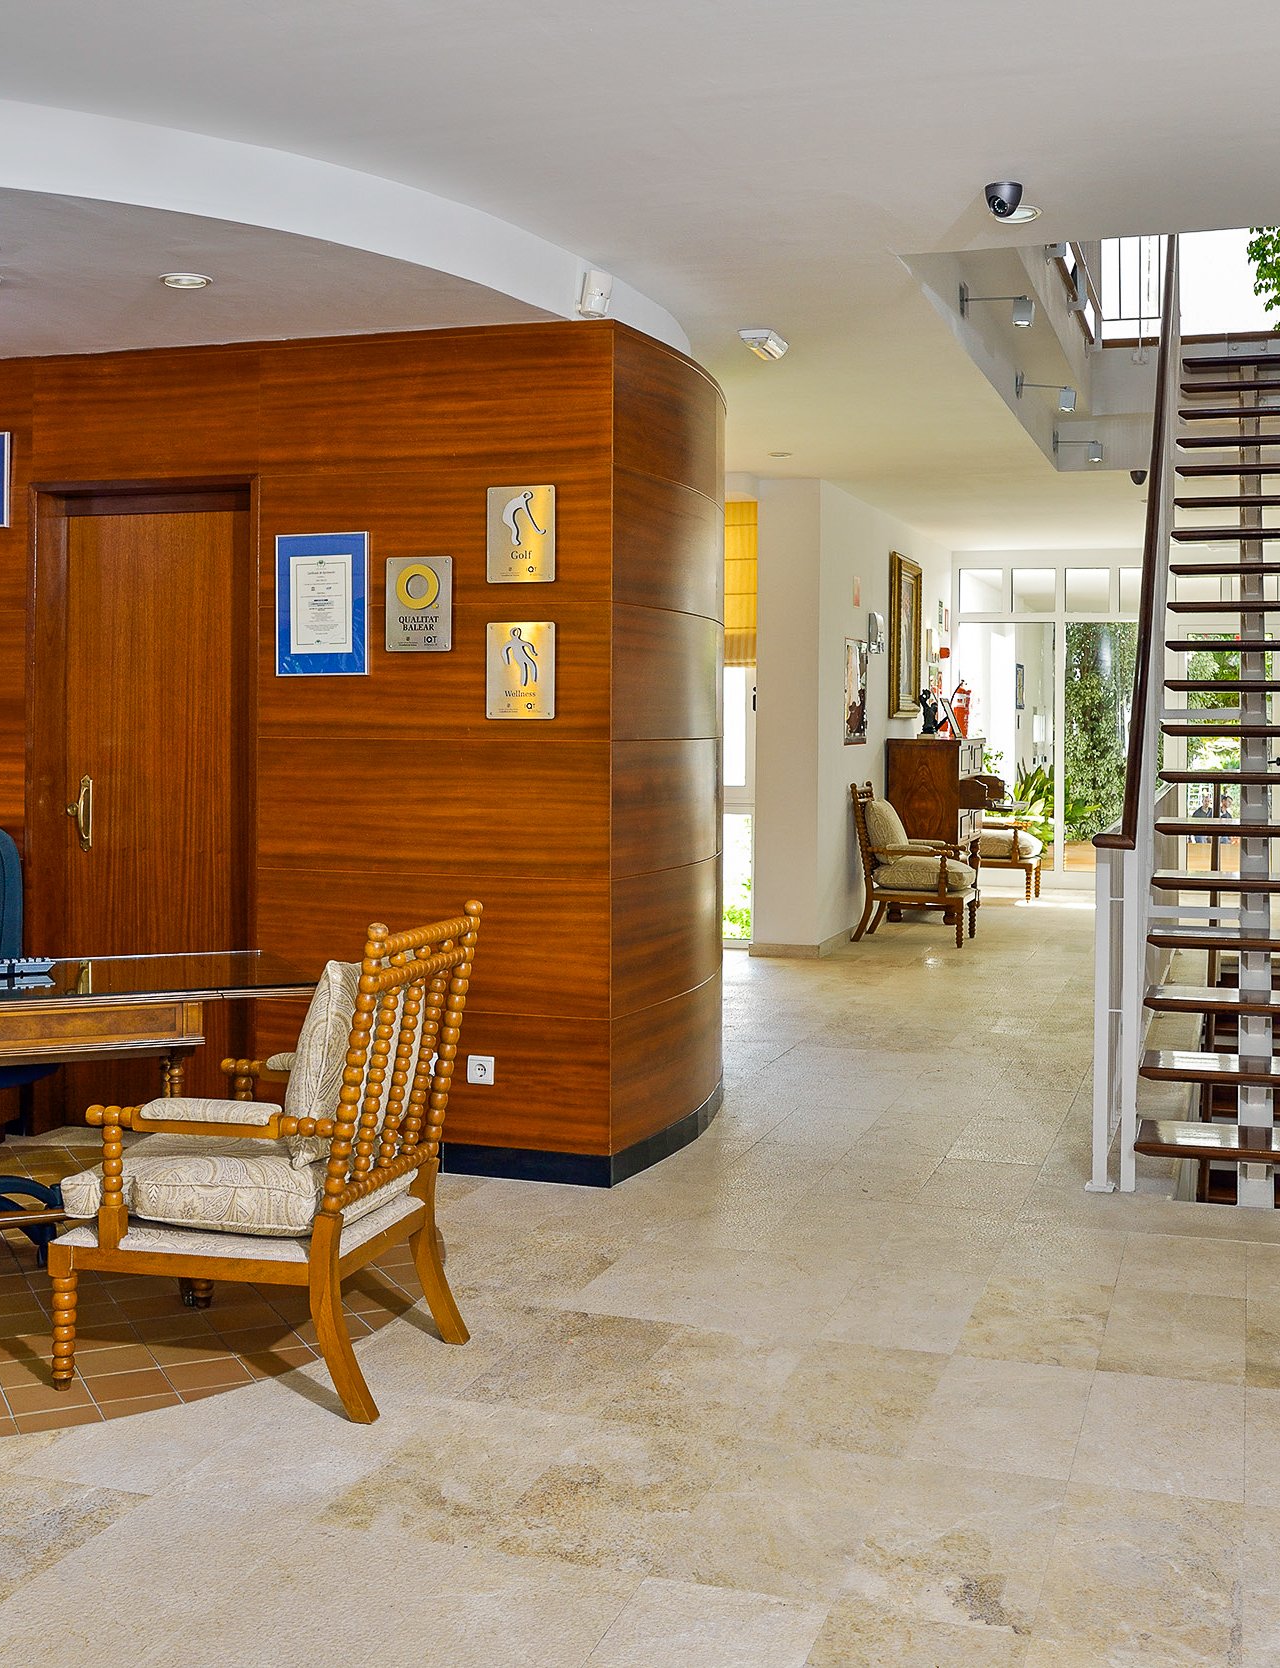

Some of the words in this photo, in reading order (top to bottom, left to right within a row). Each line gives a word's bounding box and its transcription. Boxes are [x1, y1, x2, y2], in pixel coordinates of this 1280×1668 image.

[510, 550, 532, 560] Golf
[398, 615, 439, 624] QUALITAT
[402, 623, 435, 631] BALEAR
[504, 690, 536, 698] Wellness
